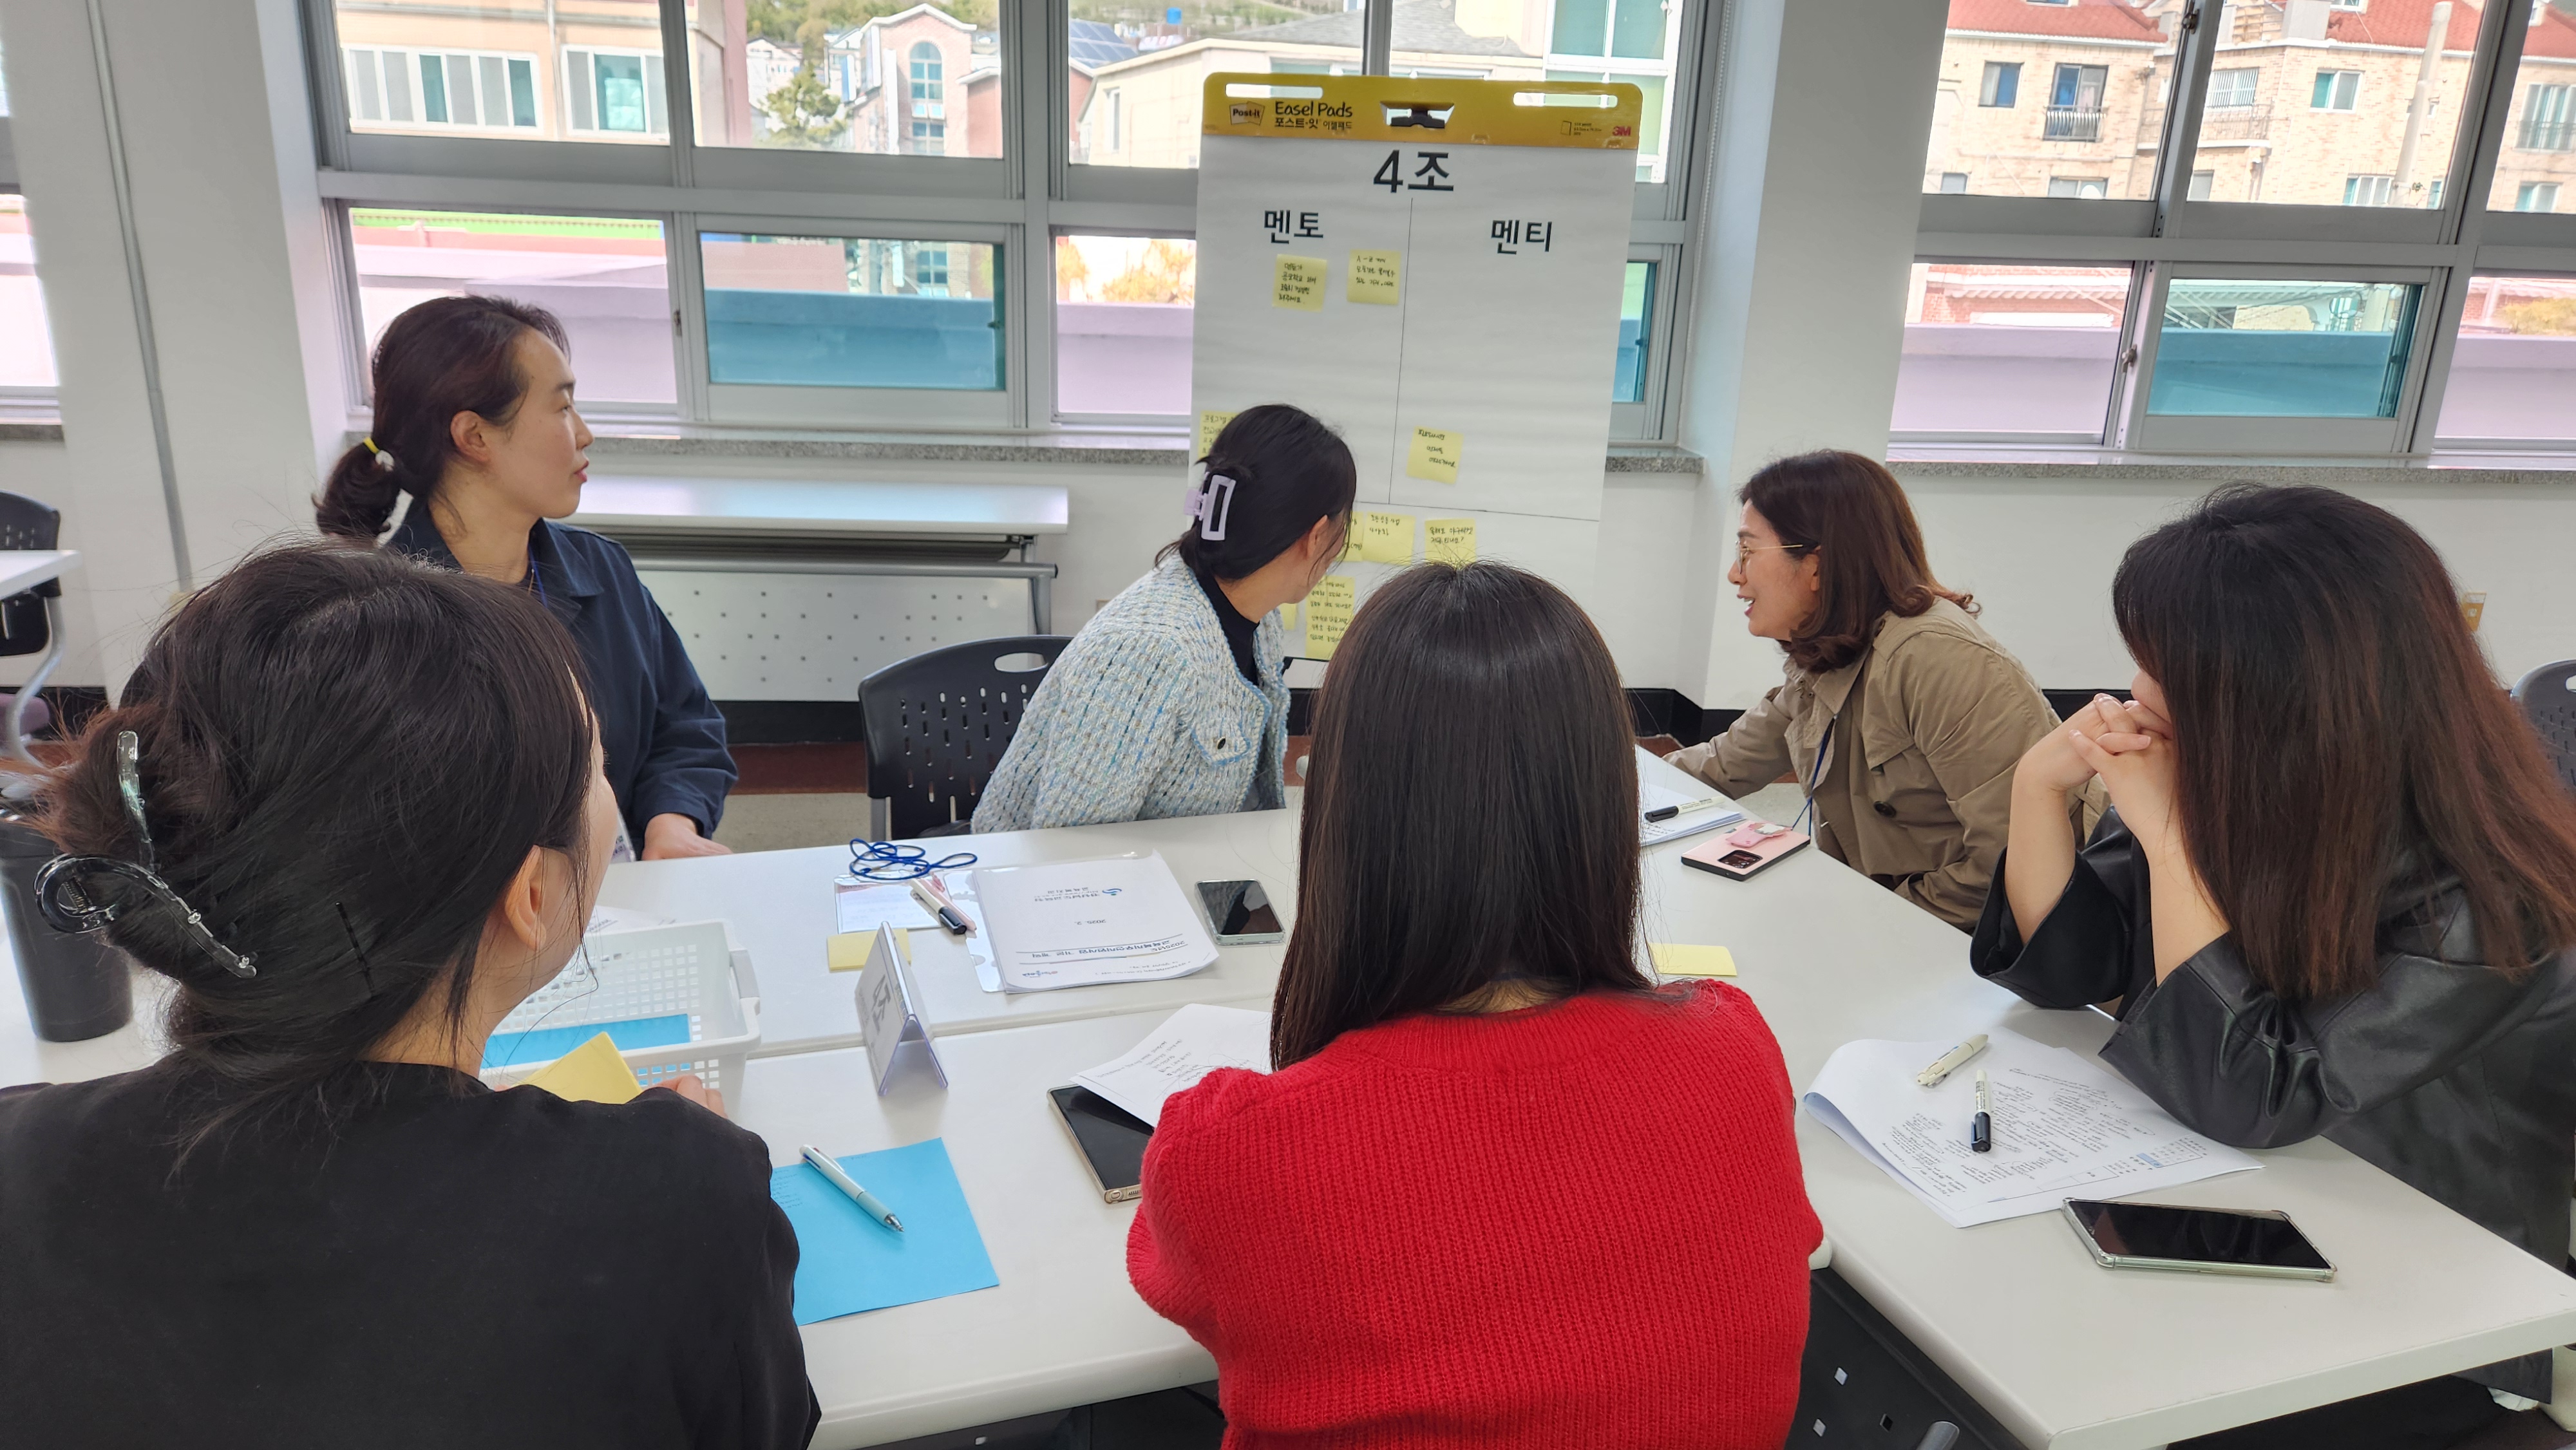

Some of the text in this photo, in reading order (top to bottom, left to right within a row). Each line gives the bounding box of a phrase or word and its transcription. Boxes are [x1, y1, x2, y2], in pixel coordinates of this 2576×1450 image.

[1232, 108, 1261, 118] Post-it
[1274, 100, 1353, 118] Easel Pads
[1323, 120, 1352, 130] 이젤패드
[1612, 125, 1632, 137] 3M
[1373, 149, 1454, 193] 4조
[1264, 209, 1323, 245] 멘토
[1491, 219, 1553, 255] 멘티
